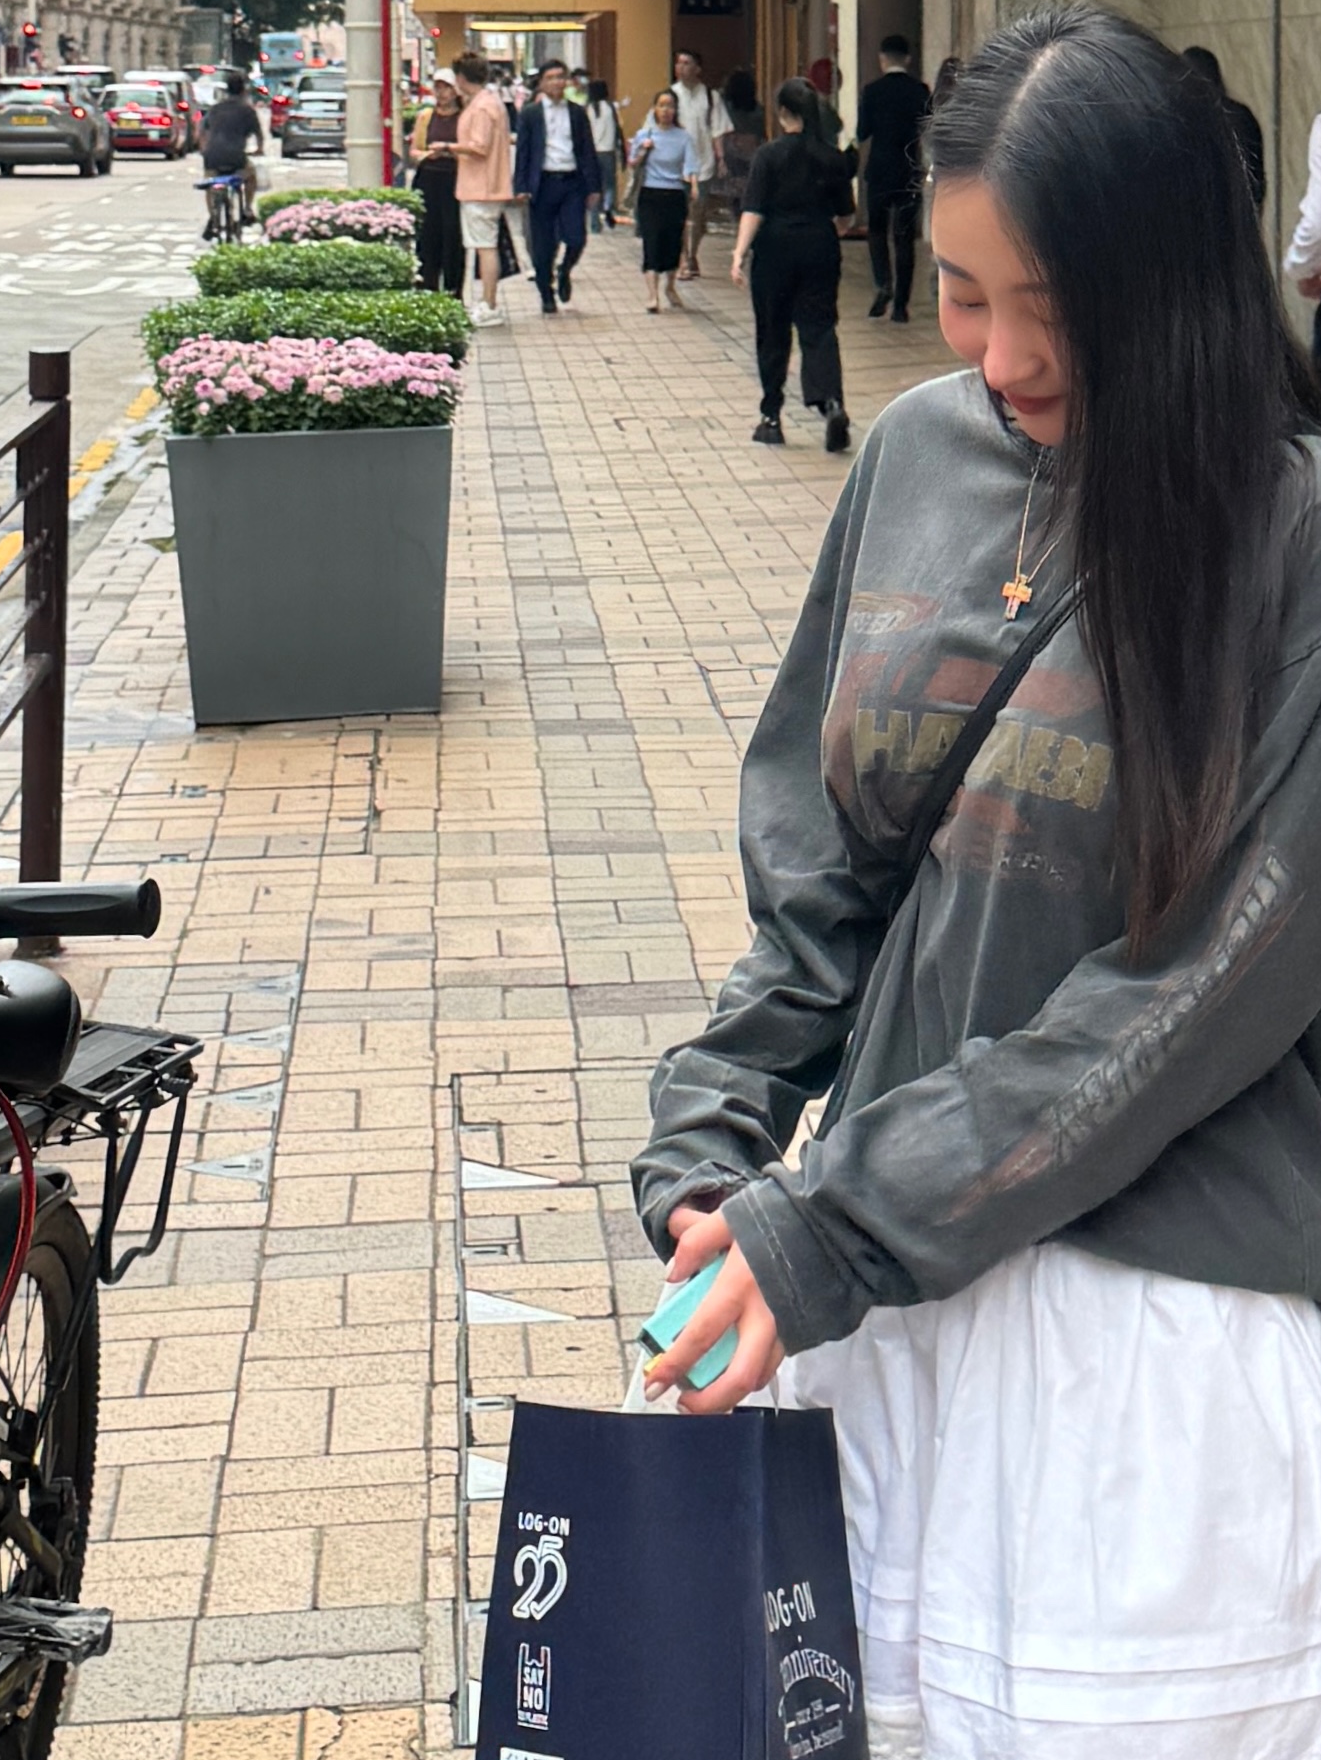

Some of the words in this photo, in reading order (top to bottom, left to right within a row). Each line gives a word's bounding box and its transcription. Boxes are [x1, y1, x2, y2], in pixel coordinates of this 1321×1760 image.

[518, 1511, 570, 1536] LOG-ON
[763, 1581, 817, 1633] LOG-ON
[523, 1665, 545, 1686] SAY
[523, 1688, 544, 1711] NO
